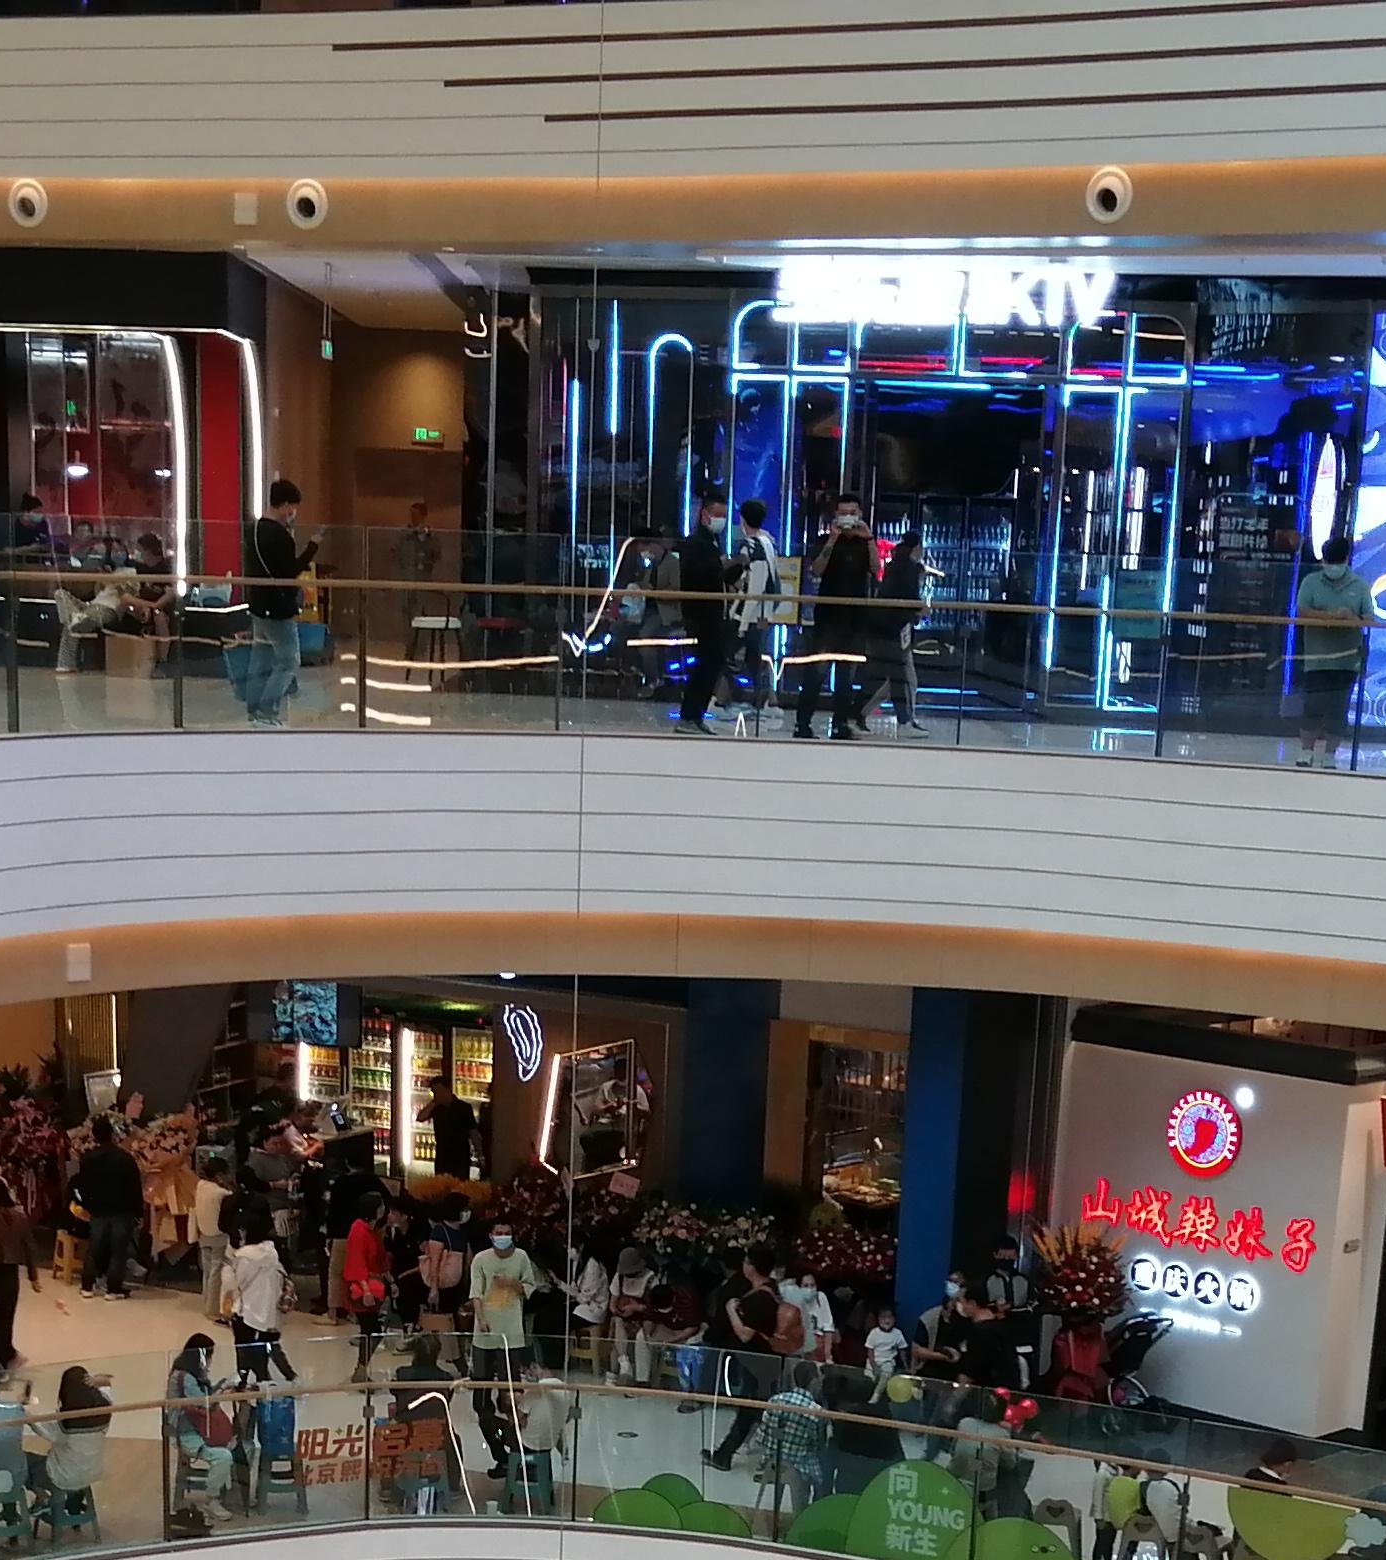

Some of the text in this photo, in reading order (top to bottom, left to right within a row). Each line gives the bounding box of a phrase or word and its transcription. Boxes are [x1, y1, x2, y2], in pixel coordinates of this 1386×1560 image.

[1082, 1177, 1318, 1274] 山城辣妹子
[888, 1464, 918, 1498] 向
[887, 1498, 965, 1531] YOUNG
[885, 1523, 938, 1557] 新生
